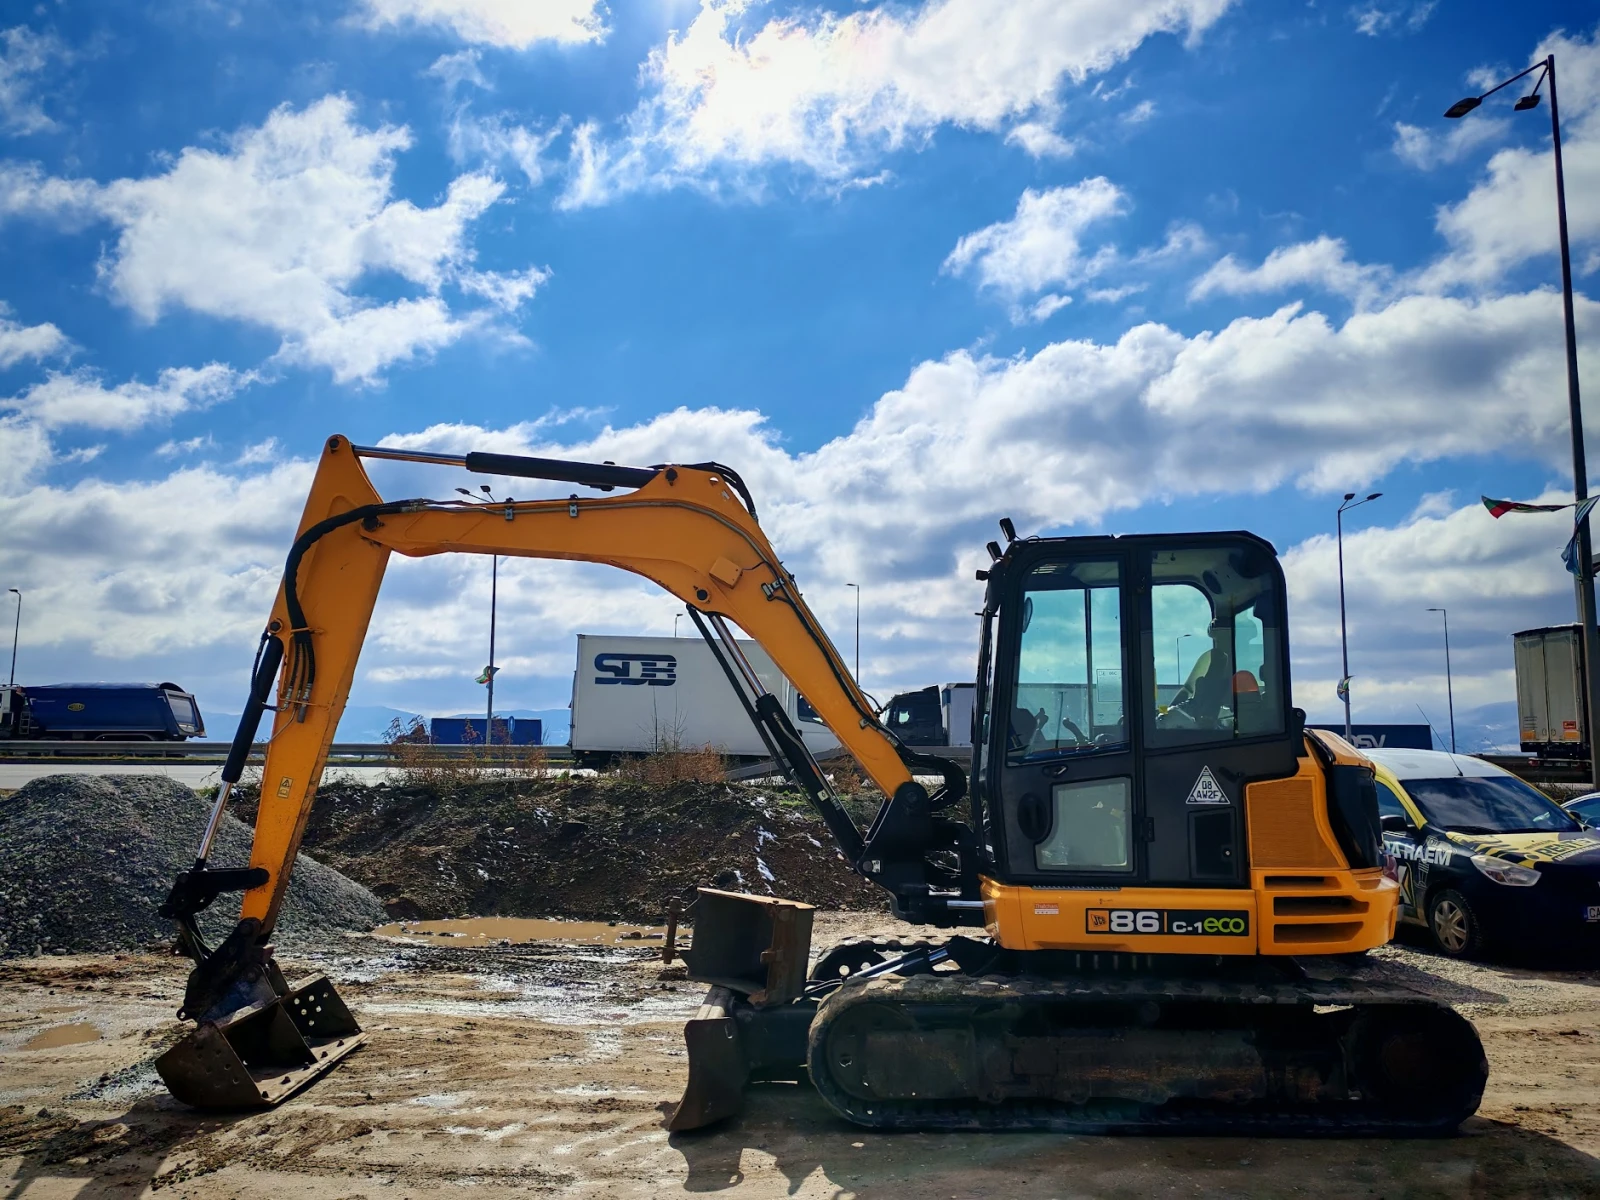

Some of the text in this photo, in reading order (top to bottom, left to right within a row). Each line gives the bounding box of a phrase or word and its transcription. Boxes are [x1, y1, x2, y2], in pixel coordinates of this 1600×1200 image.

[594, 653, 677, 686] SDB
[1110, 911, 1160, 933] 86
[1203, 917, 1245, 933] eco
